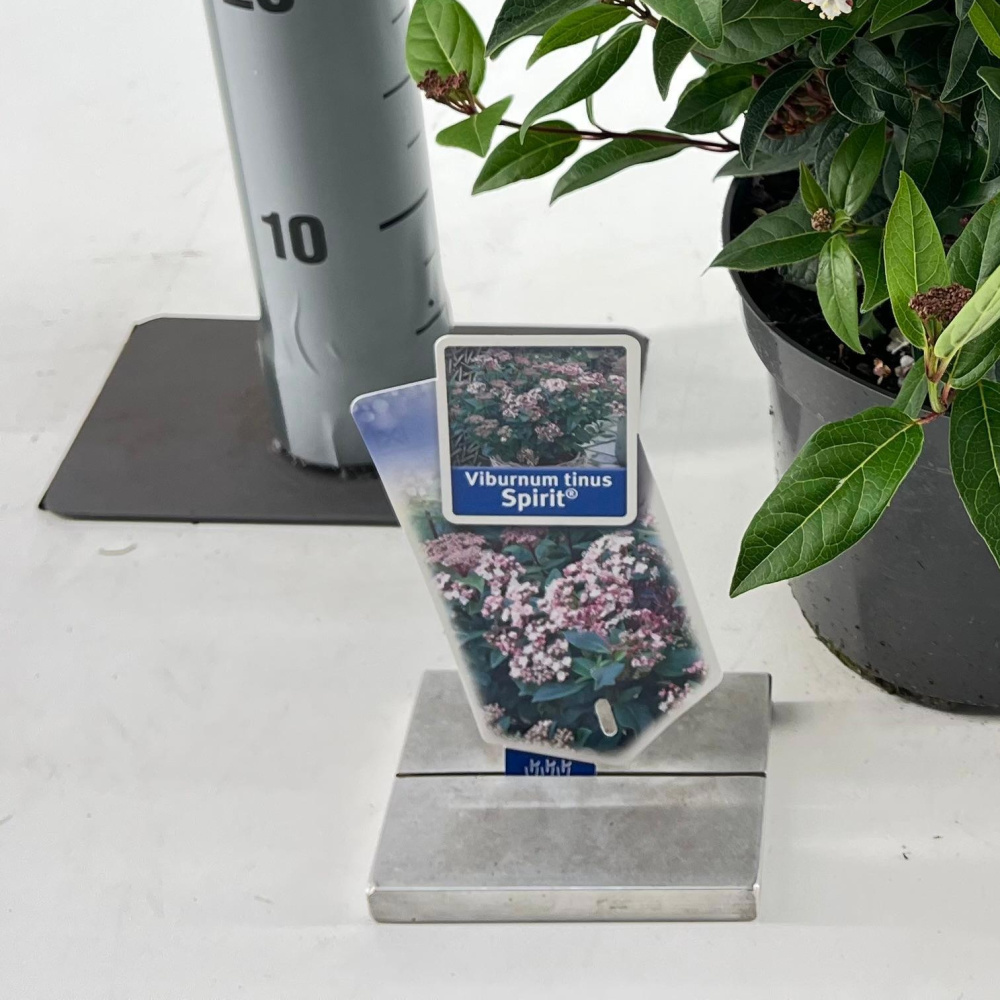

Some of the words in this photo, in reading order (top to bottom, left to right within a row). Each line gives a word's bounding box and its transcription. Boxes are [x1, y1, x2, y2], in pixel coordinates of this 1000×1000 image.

[261, 211, 328, 264] 10
[464, 471, 558, 487] Viburnum
[564, 471, 613, 487] tinus
